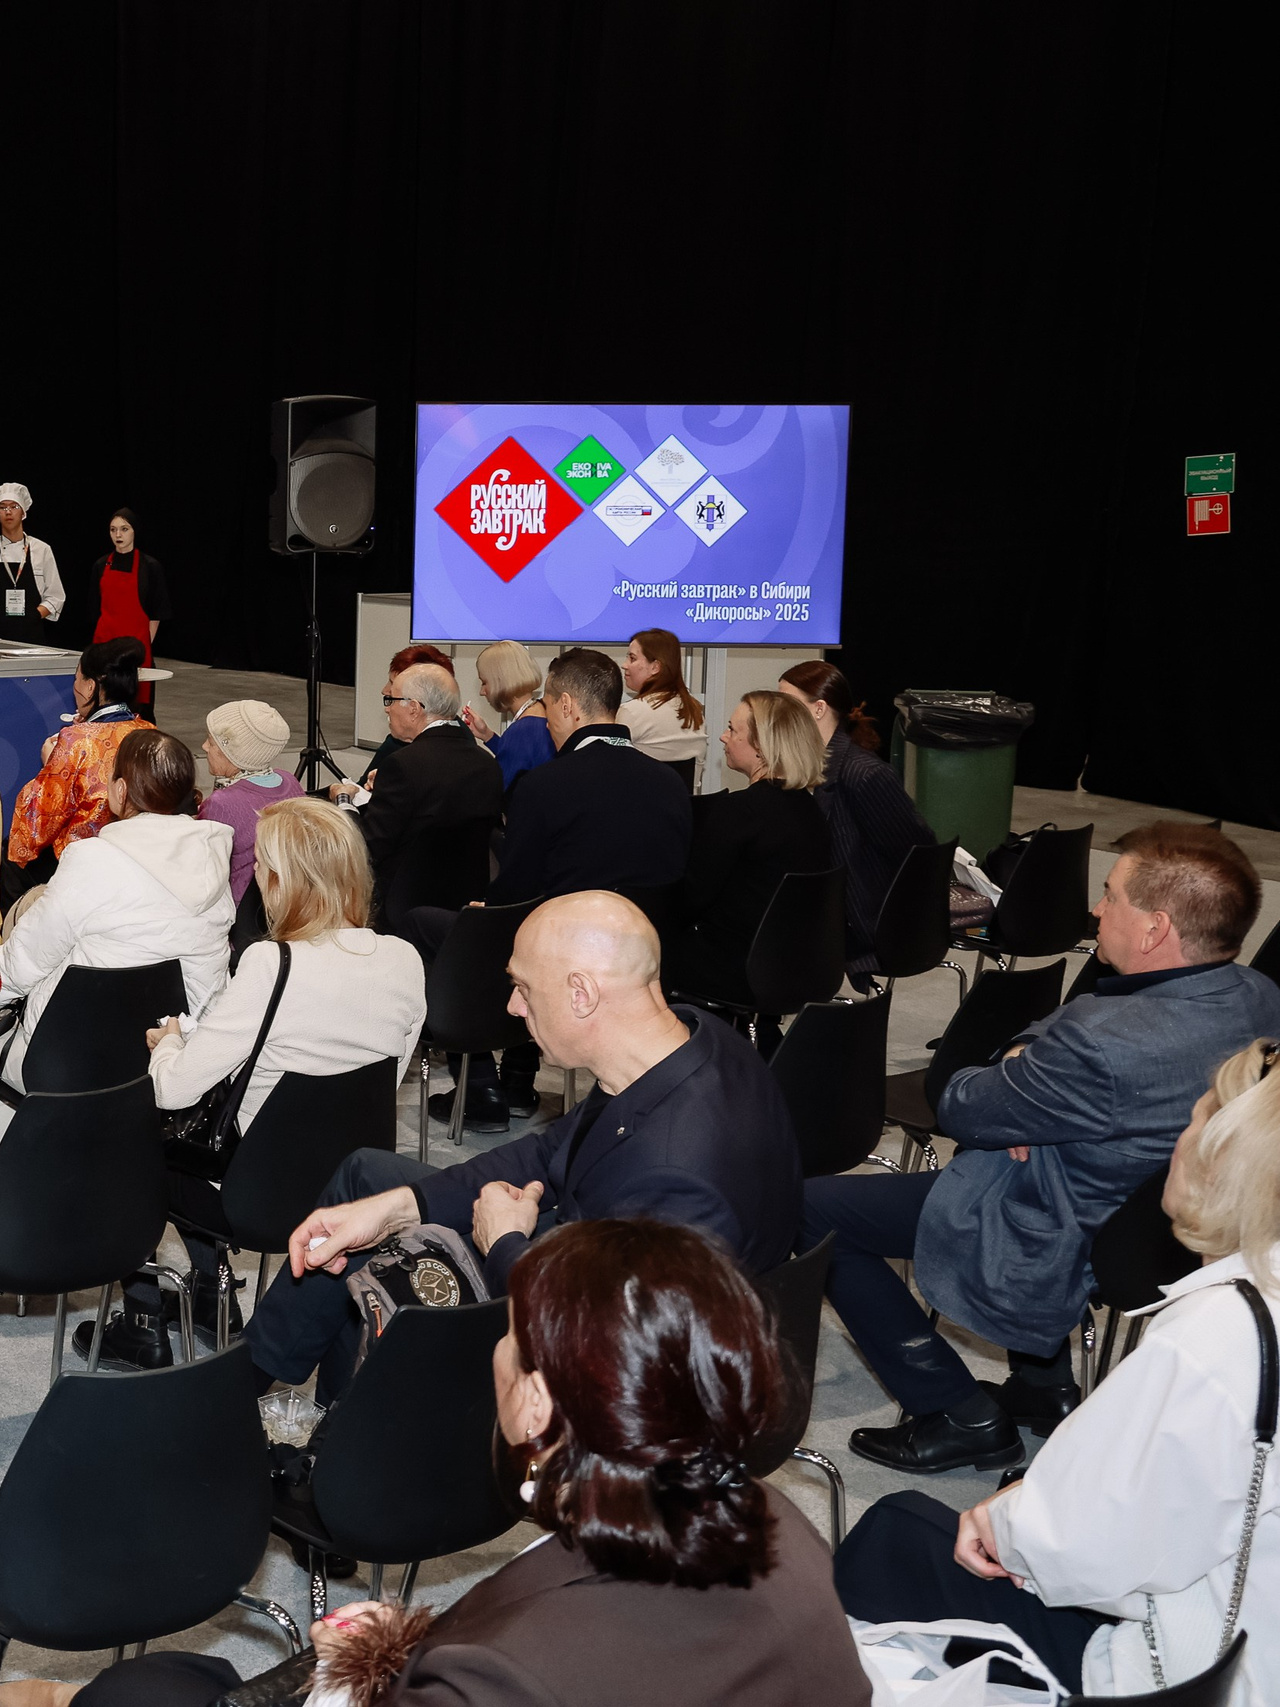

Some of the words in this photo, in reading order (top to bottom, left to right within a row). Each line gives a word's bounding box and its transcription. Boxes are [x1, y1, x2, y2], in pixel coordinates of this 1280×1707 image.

[470, 468, 547, 510] РУССКИЙ
[470, 508, 547, 551] ЗАВТРАК
[612, 580, 678, 601] «Русский
[681, 583, 747, 602] завтрак»
[749, 585, 758, 599] в
[761, 581, 811, 602] Сибири
[685, 602, 772, 624] «Дикоросы»
[774, 603, 810, 622] 2025
